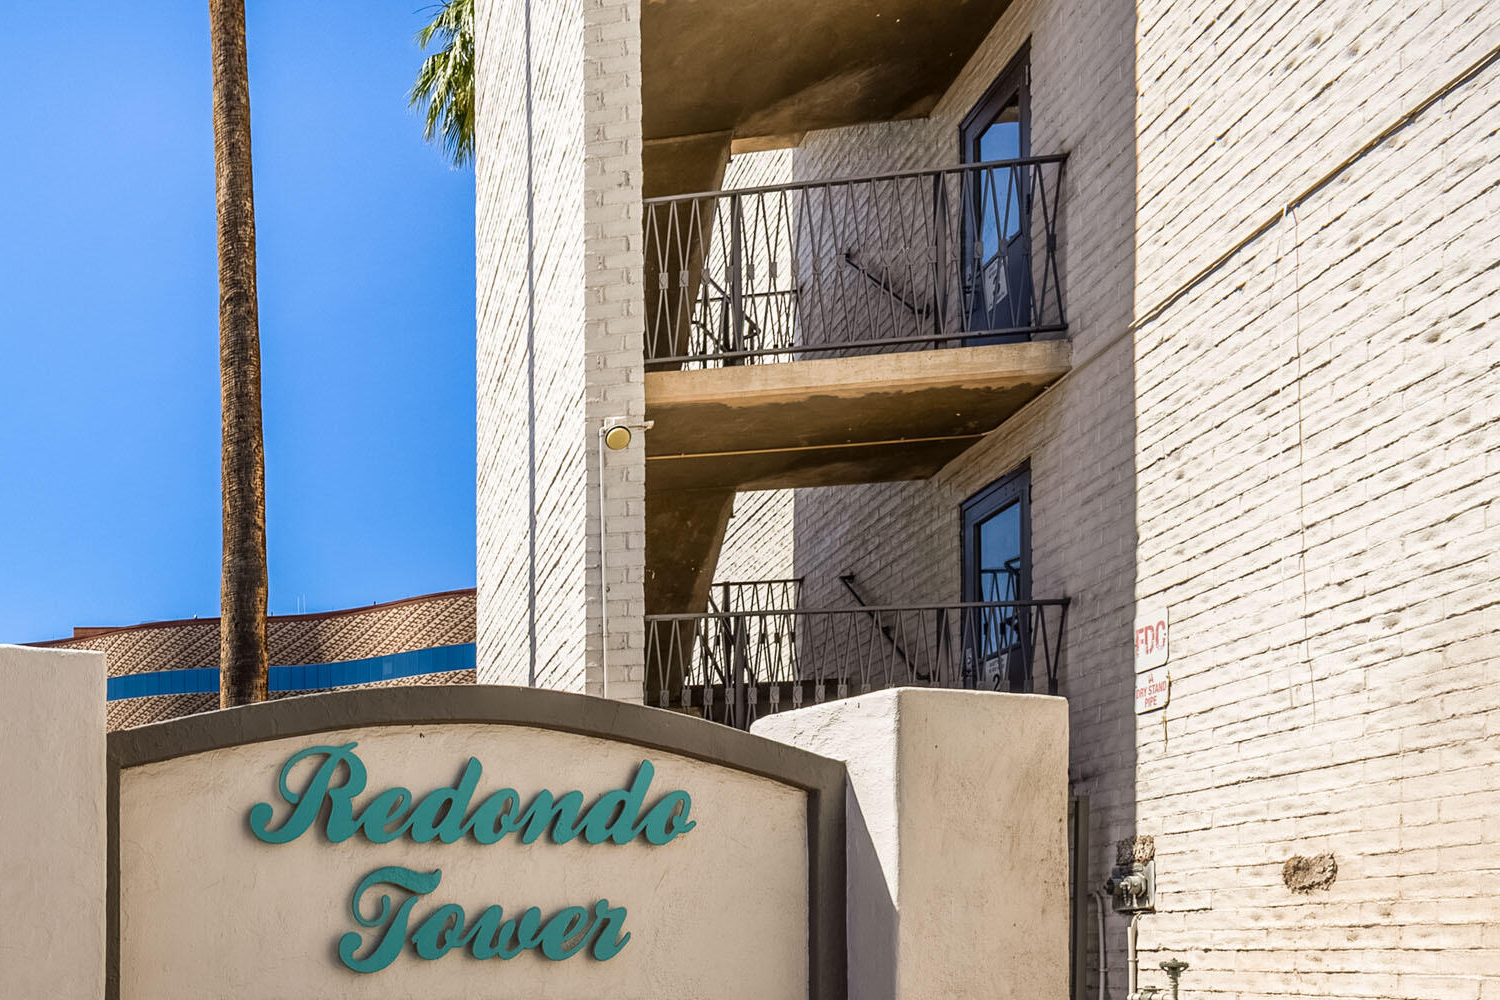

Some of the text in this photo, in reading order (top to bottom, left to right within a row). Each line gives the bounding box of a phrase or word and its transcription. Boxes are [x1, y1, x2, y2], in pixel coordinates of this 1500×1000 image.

[1135, 620, 1166, 656] FDC
[1145, 696, 1157, 708] PIPE
[1148, 680, 1167, 696] STAND
[249, 741, 697, 846] Redondo
[338, 865, 632, 974] Tower
